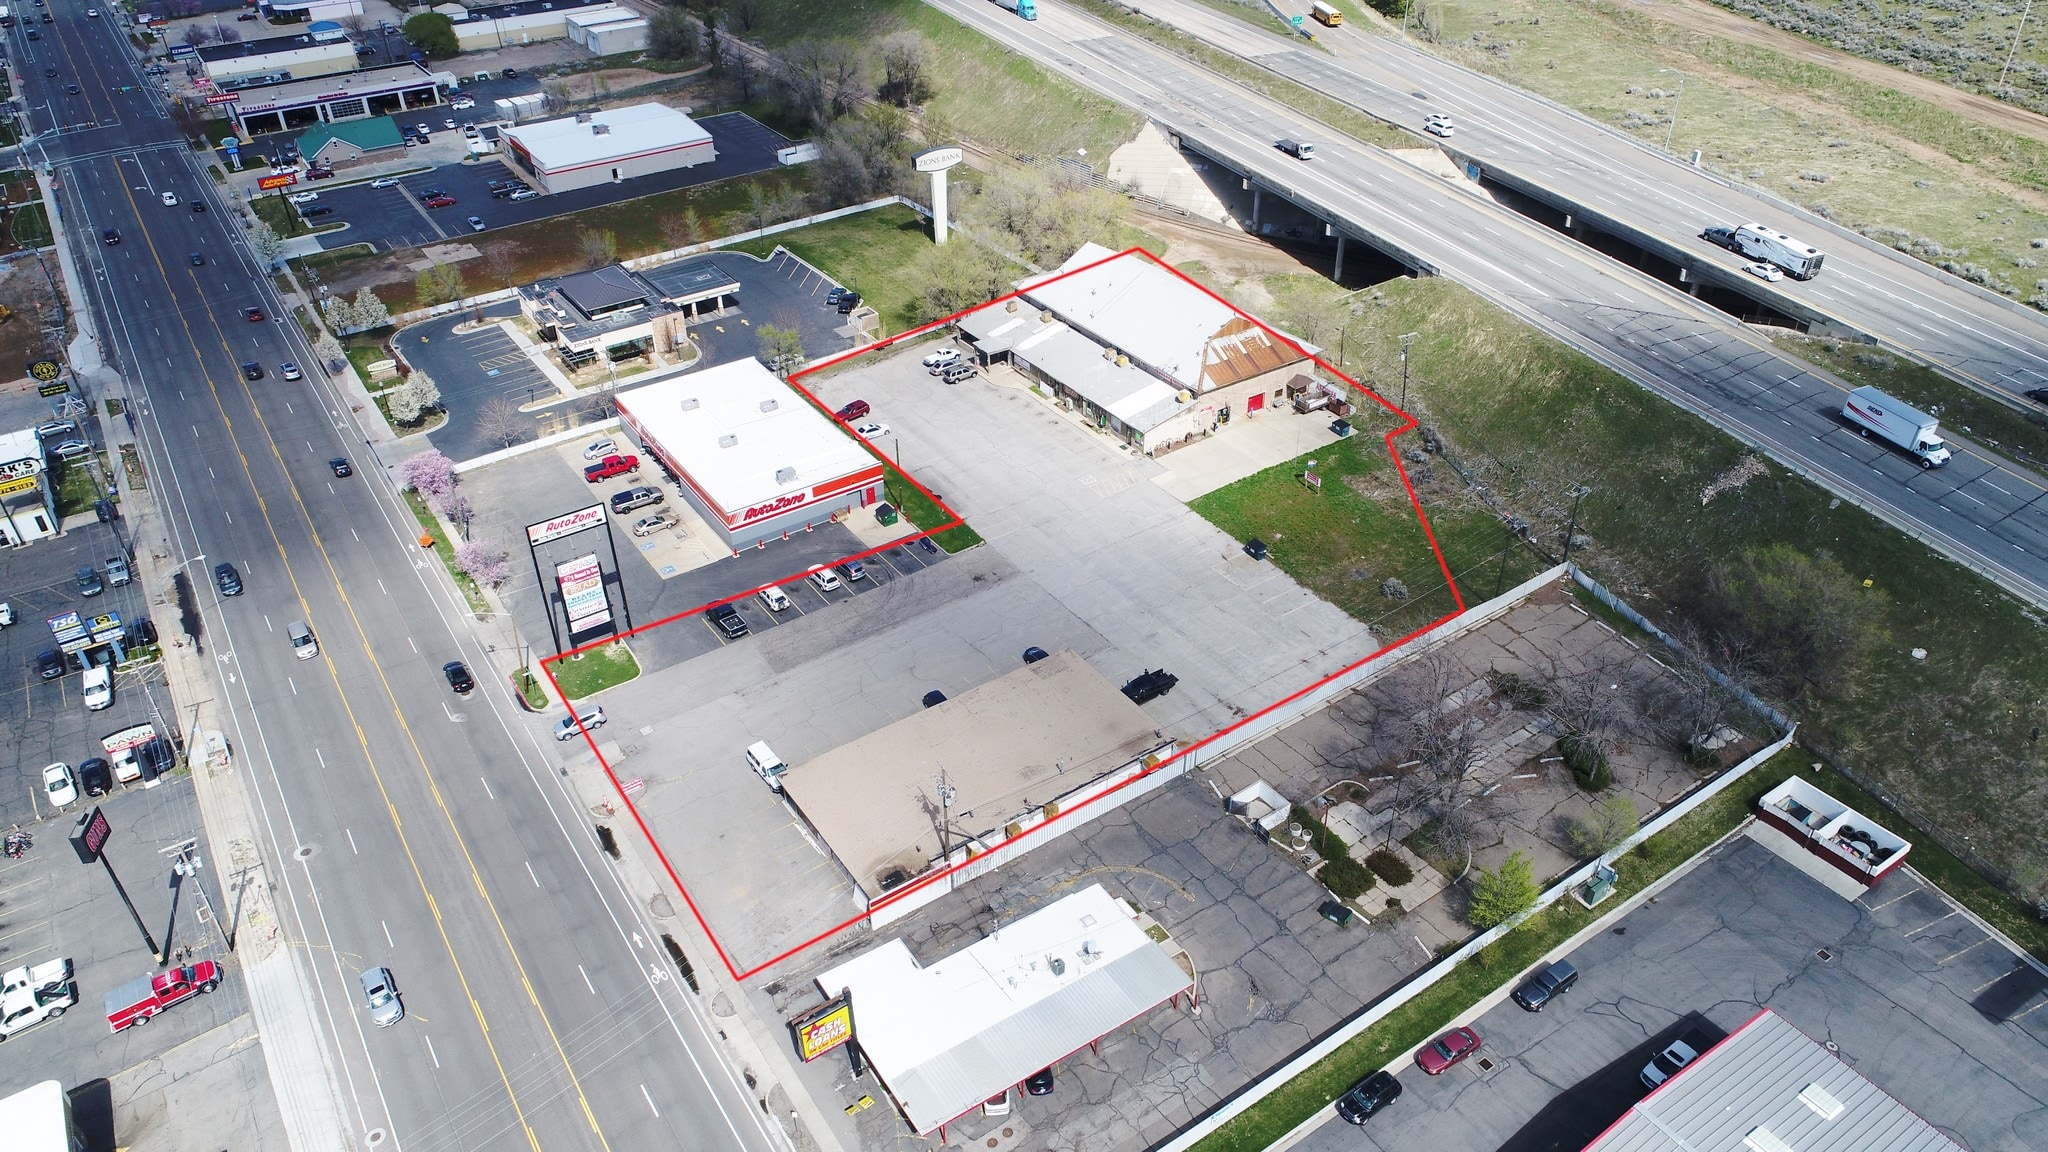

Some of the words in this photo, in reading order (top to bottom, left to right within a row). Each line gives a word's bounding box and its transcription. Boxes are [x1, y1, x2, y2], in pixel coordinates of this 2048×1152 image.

[206, 94, 238, 103] Firestone
[918, 157, 941, 168] ZIONS
[941, 152, 961, 163] BANK
[15, 469, 35, 478] CARE
[743, 493, 805, 521] AutoZone
[546, 510, 598, 533] AutoZone
[52, 615, 77, 629] TSO
[107, 730, 152, 748] PAWN
[811, 1016, 842, 1039] CASH
[808, 1024, 847, 1050] LOANS
